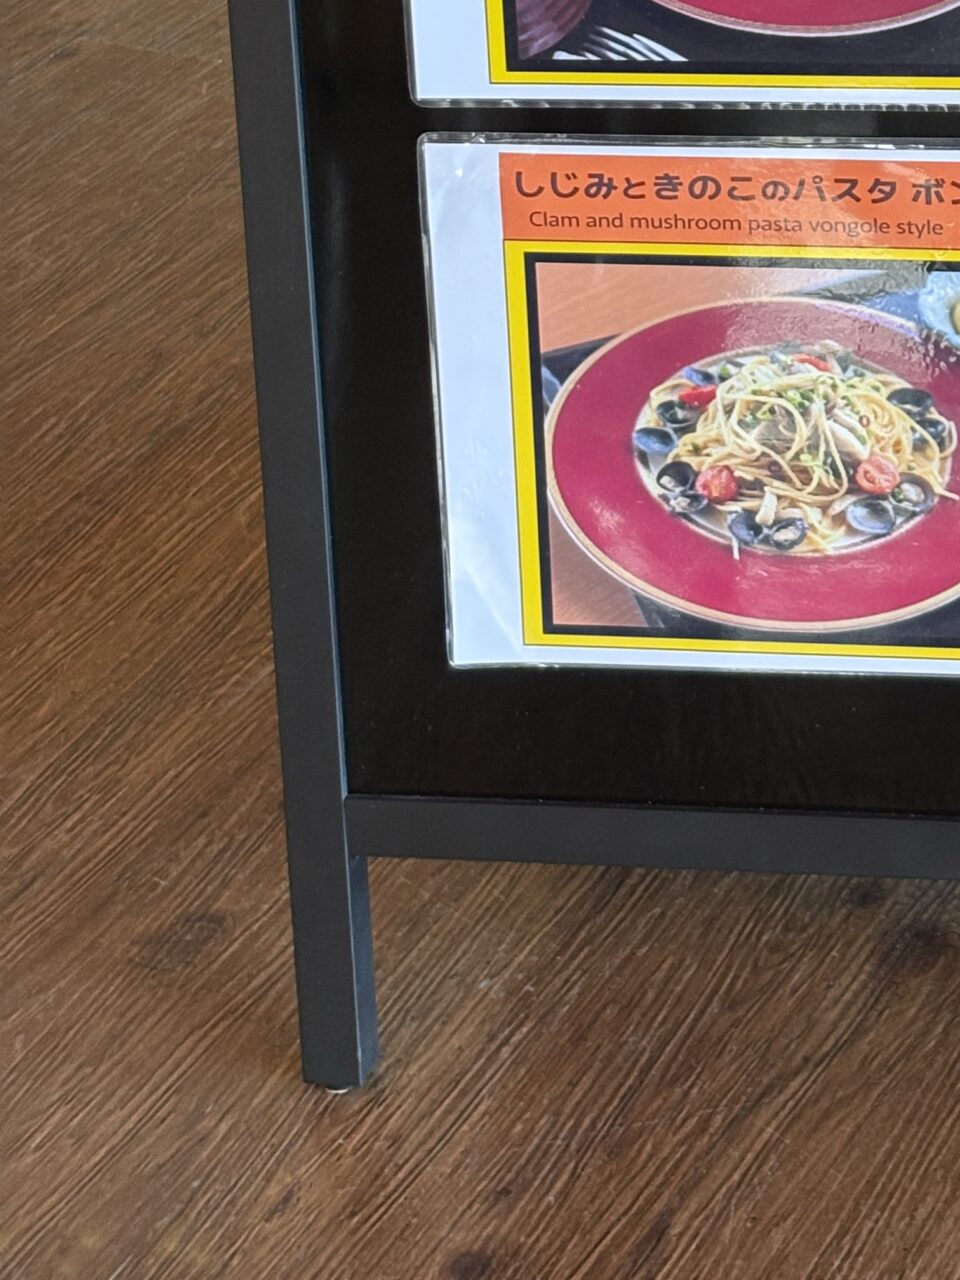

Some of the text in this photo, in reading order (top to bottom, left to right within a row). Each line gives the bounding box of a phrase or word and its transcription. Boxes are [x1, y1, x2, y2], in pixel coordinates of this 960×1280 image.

[515, 170, 898, 205] しじみときのこのパスタ
[528, 210, 945, 239] Clam and mushroom pasta vongole style
